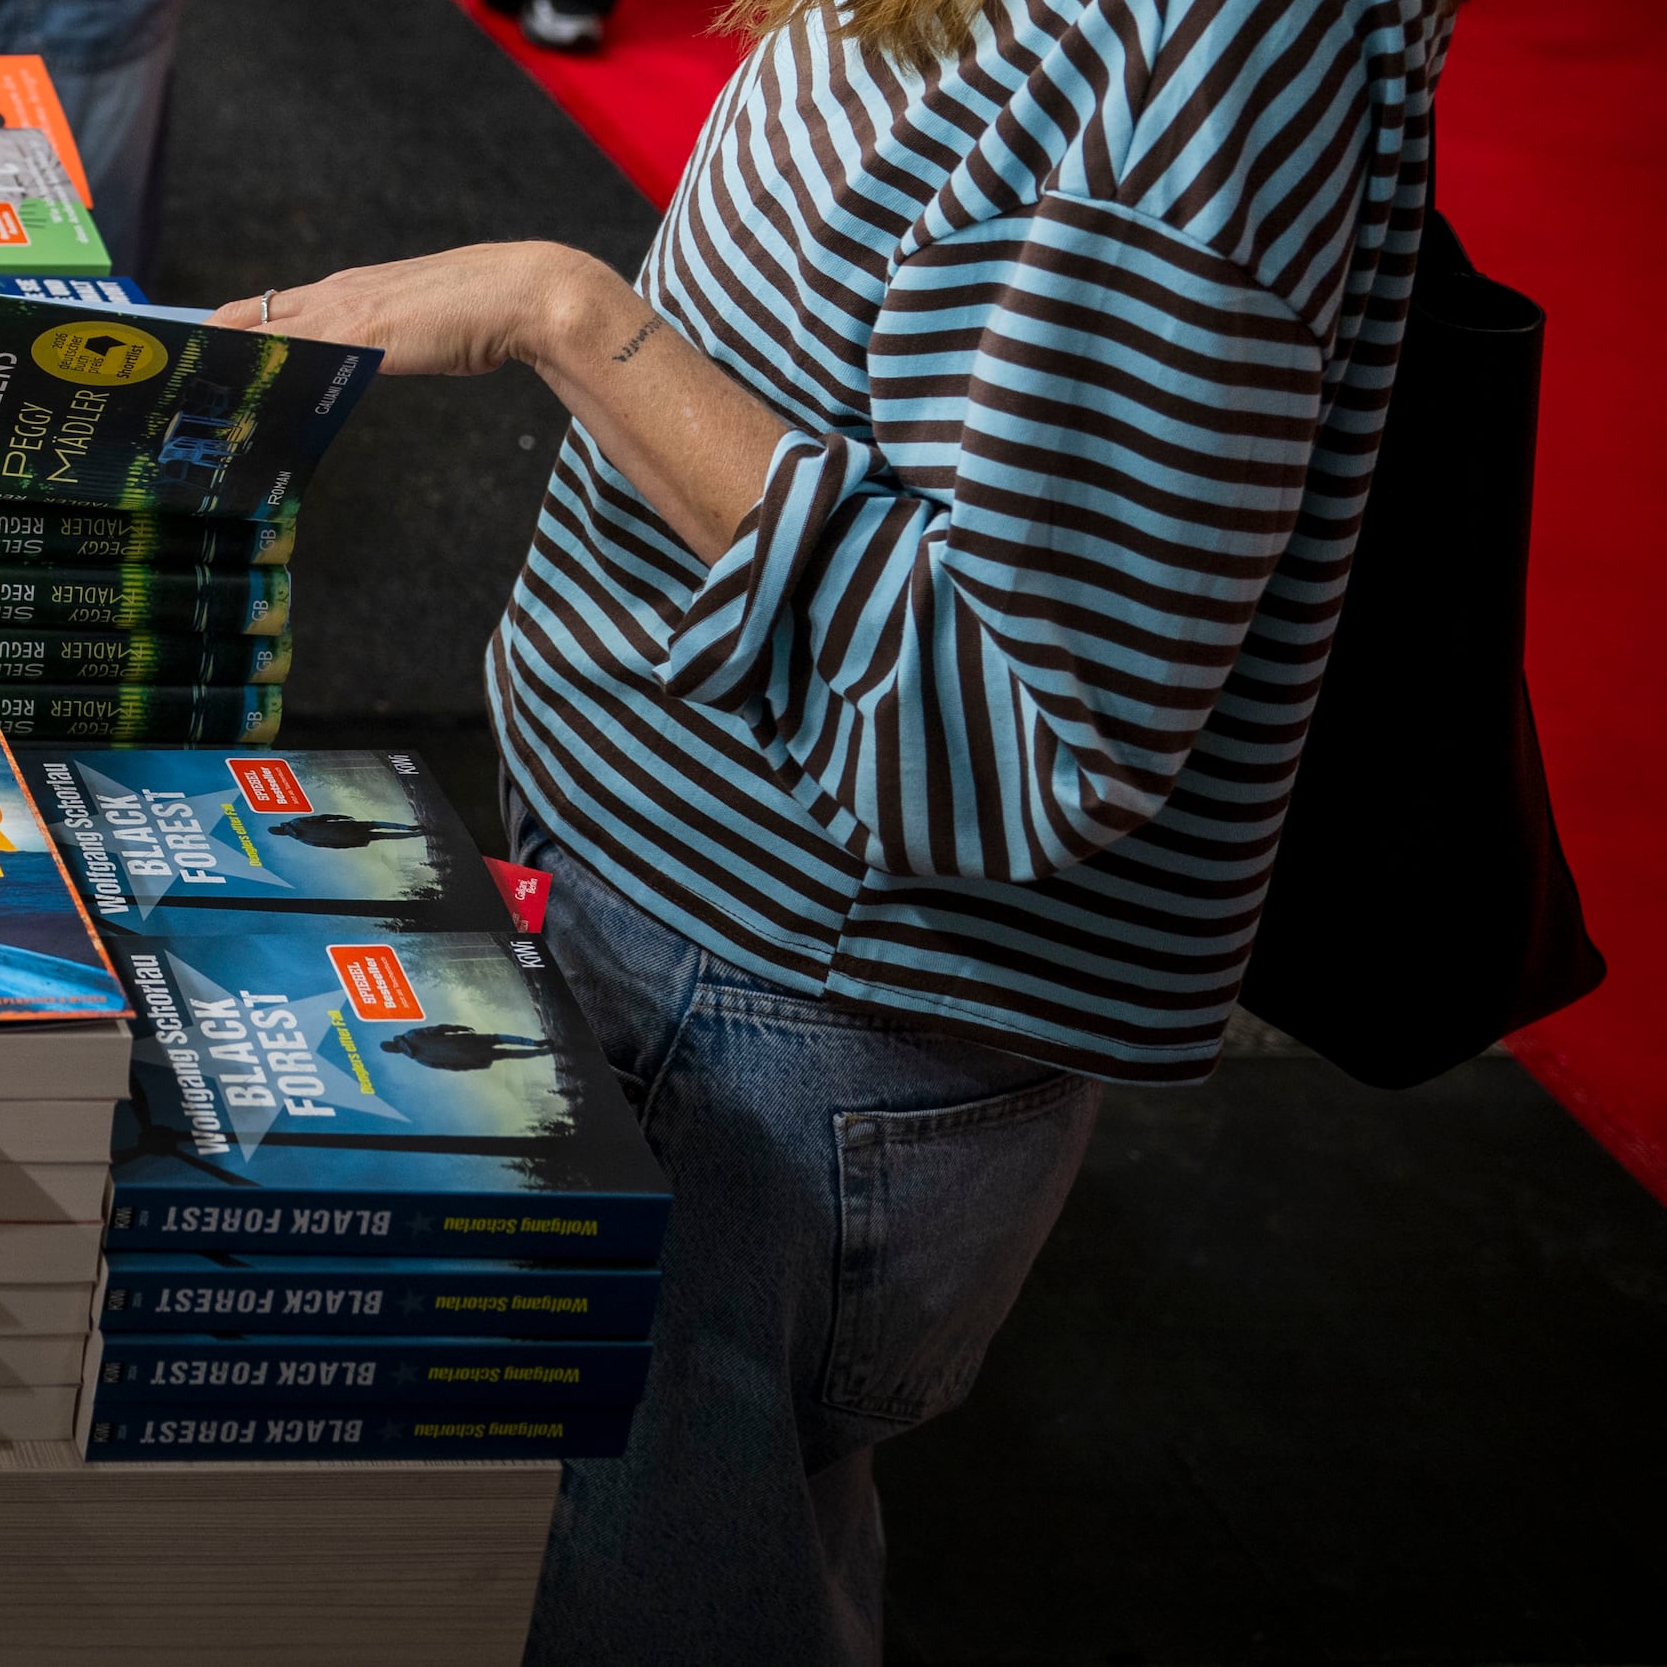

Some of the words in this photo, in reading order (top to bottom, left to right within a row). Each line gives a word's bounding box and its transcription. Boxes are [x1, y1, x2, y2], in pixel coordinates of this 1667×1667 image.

[57, 334, 83, 372] deutscher
[70, 353, 90, 375] buch
[87, 356, 106, 376] preis
[116, 343, 145, 381] Shortlist
[332, 353, 360, 385] BERLIN
[1, 400, 55, 480] PEGGY
[45, 388, 111, 484] MÄDLER
[267, 469, 292, 506] ROMAN
[387, 753, 420, 775] KiWi
[42, 762, 94, 829] Schorlau
[95, 793, 173, 877] BLACK
[141, 788, 227, 885] FOREST
[74, 831, 130, 915] Wolfgang
[514, 878, 529, 901] Galiani
[525, 877, 539, 895] Berlin
[509, 940, 546, 968] KiWi
[129, 953, 189, 1046] Schorlau
[346, 961, 378, 1006] SPIEGEL
[364, 955, 398, 1010] Bestseller
[189, 996, 277, 1108] BLACK
[238, 989, 337, 1118] FOREST
[166, 1047, 231, 1157] Wolfgang
[161, 1205, 282, 1235] FOREST
[289, 1207, 393, 1237] BLACK
[442, 1214, 517, 1235] Schorlau
[518, 1215, 599, 1238] Wolfgang
